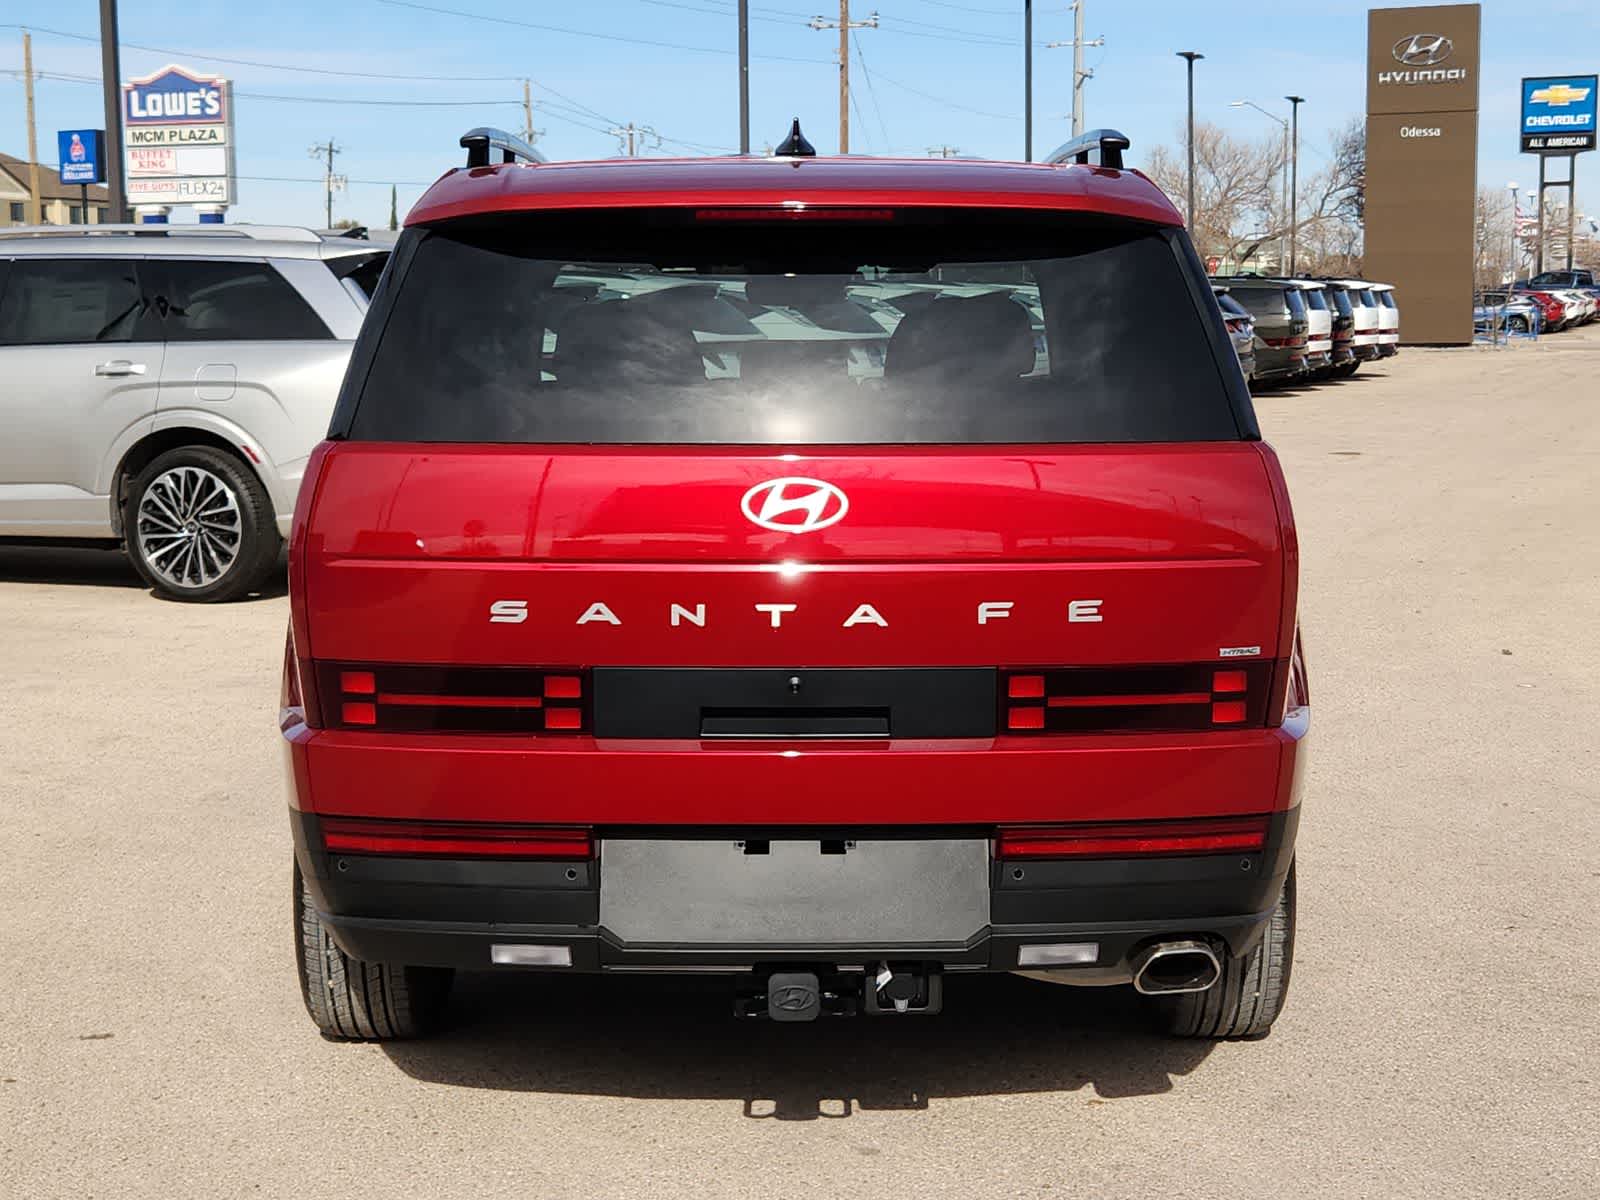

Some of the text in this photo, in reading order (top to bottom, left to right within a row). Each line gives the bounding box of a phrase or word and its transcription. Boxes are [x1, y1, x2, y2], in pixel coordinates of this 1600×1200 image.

[129, 88, 220, 117] LOWE'S
[1526, 114, 1591, 127] CHEVROLET
[132, 129, 218, 143] MCM PLAZA
[1400, 126, 1441, 138] Odessa
[1529, 137, 1587, 148] ALL AMERICAN
[131, 150, 172, 160] BUFFET
[138, 160, 166, 169] KING
[489, 599, 1103, 628] SANTA FE
